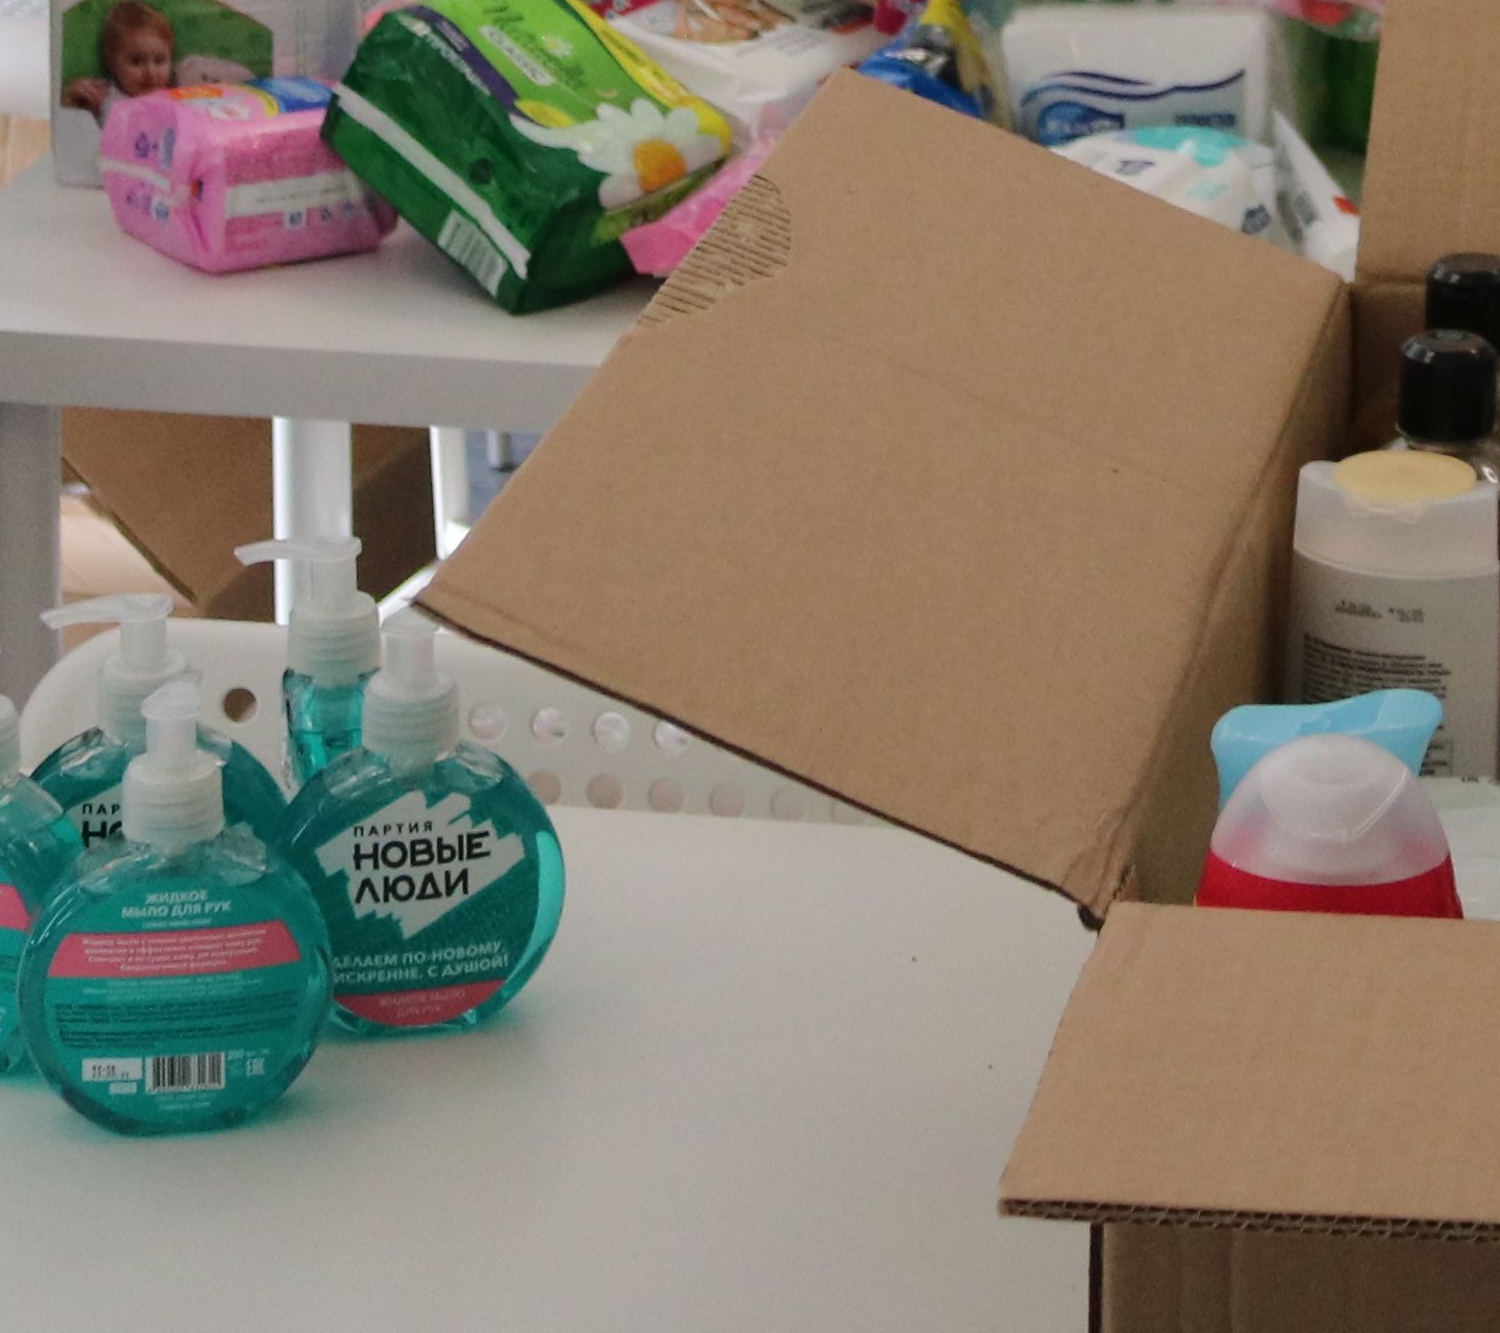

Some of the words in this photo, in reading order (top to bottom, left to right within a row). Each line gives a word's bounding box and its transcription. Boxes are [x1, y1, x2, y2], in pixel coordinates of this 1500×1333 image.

[353, 821, 433, 837] ПАРТИЯ
[353, 831, 491, 871] НОВЫЕ
[355, 868, 470, 904] ЛЮДИ
[144, 890, 208, 905] ЖИДКОЕ
[121, 904, 169, 918] МЫЛО
[171, 902, 203, 917] ДЛЯ
[204, 900, 232, 912] РУК
